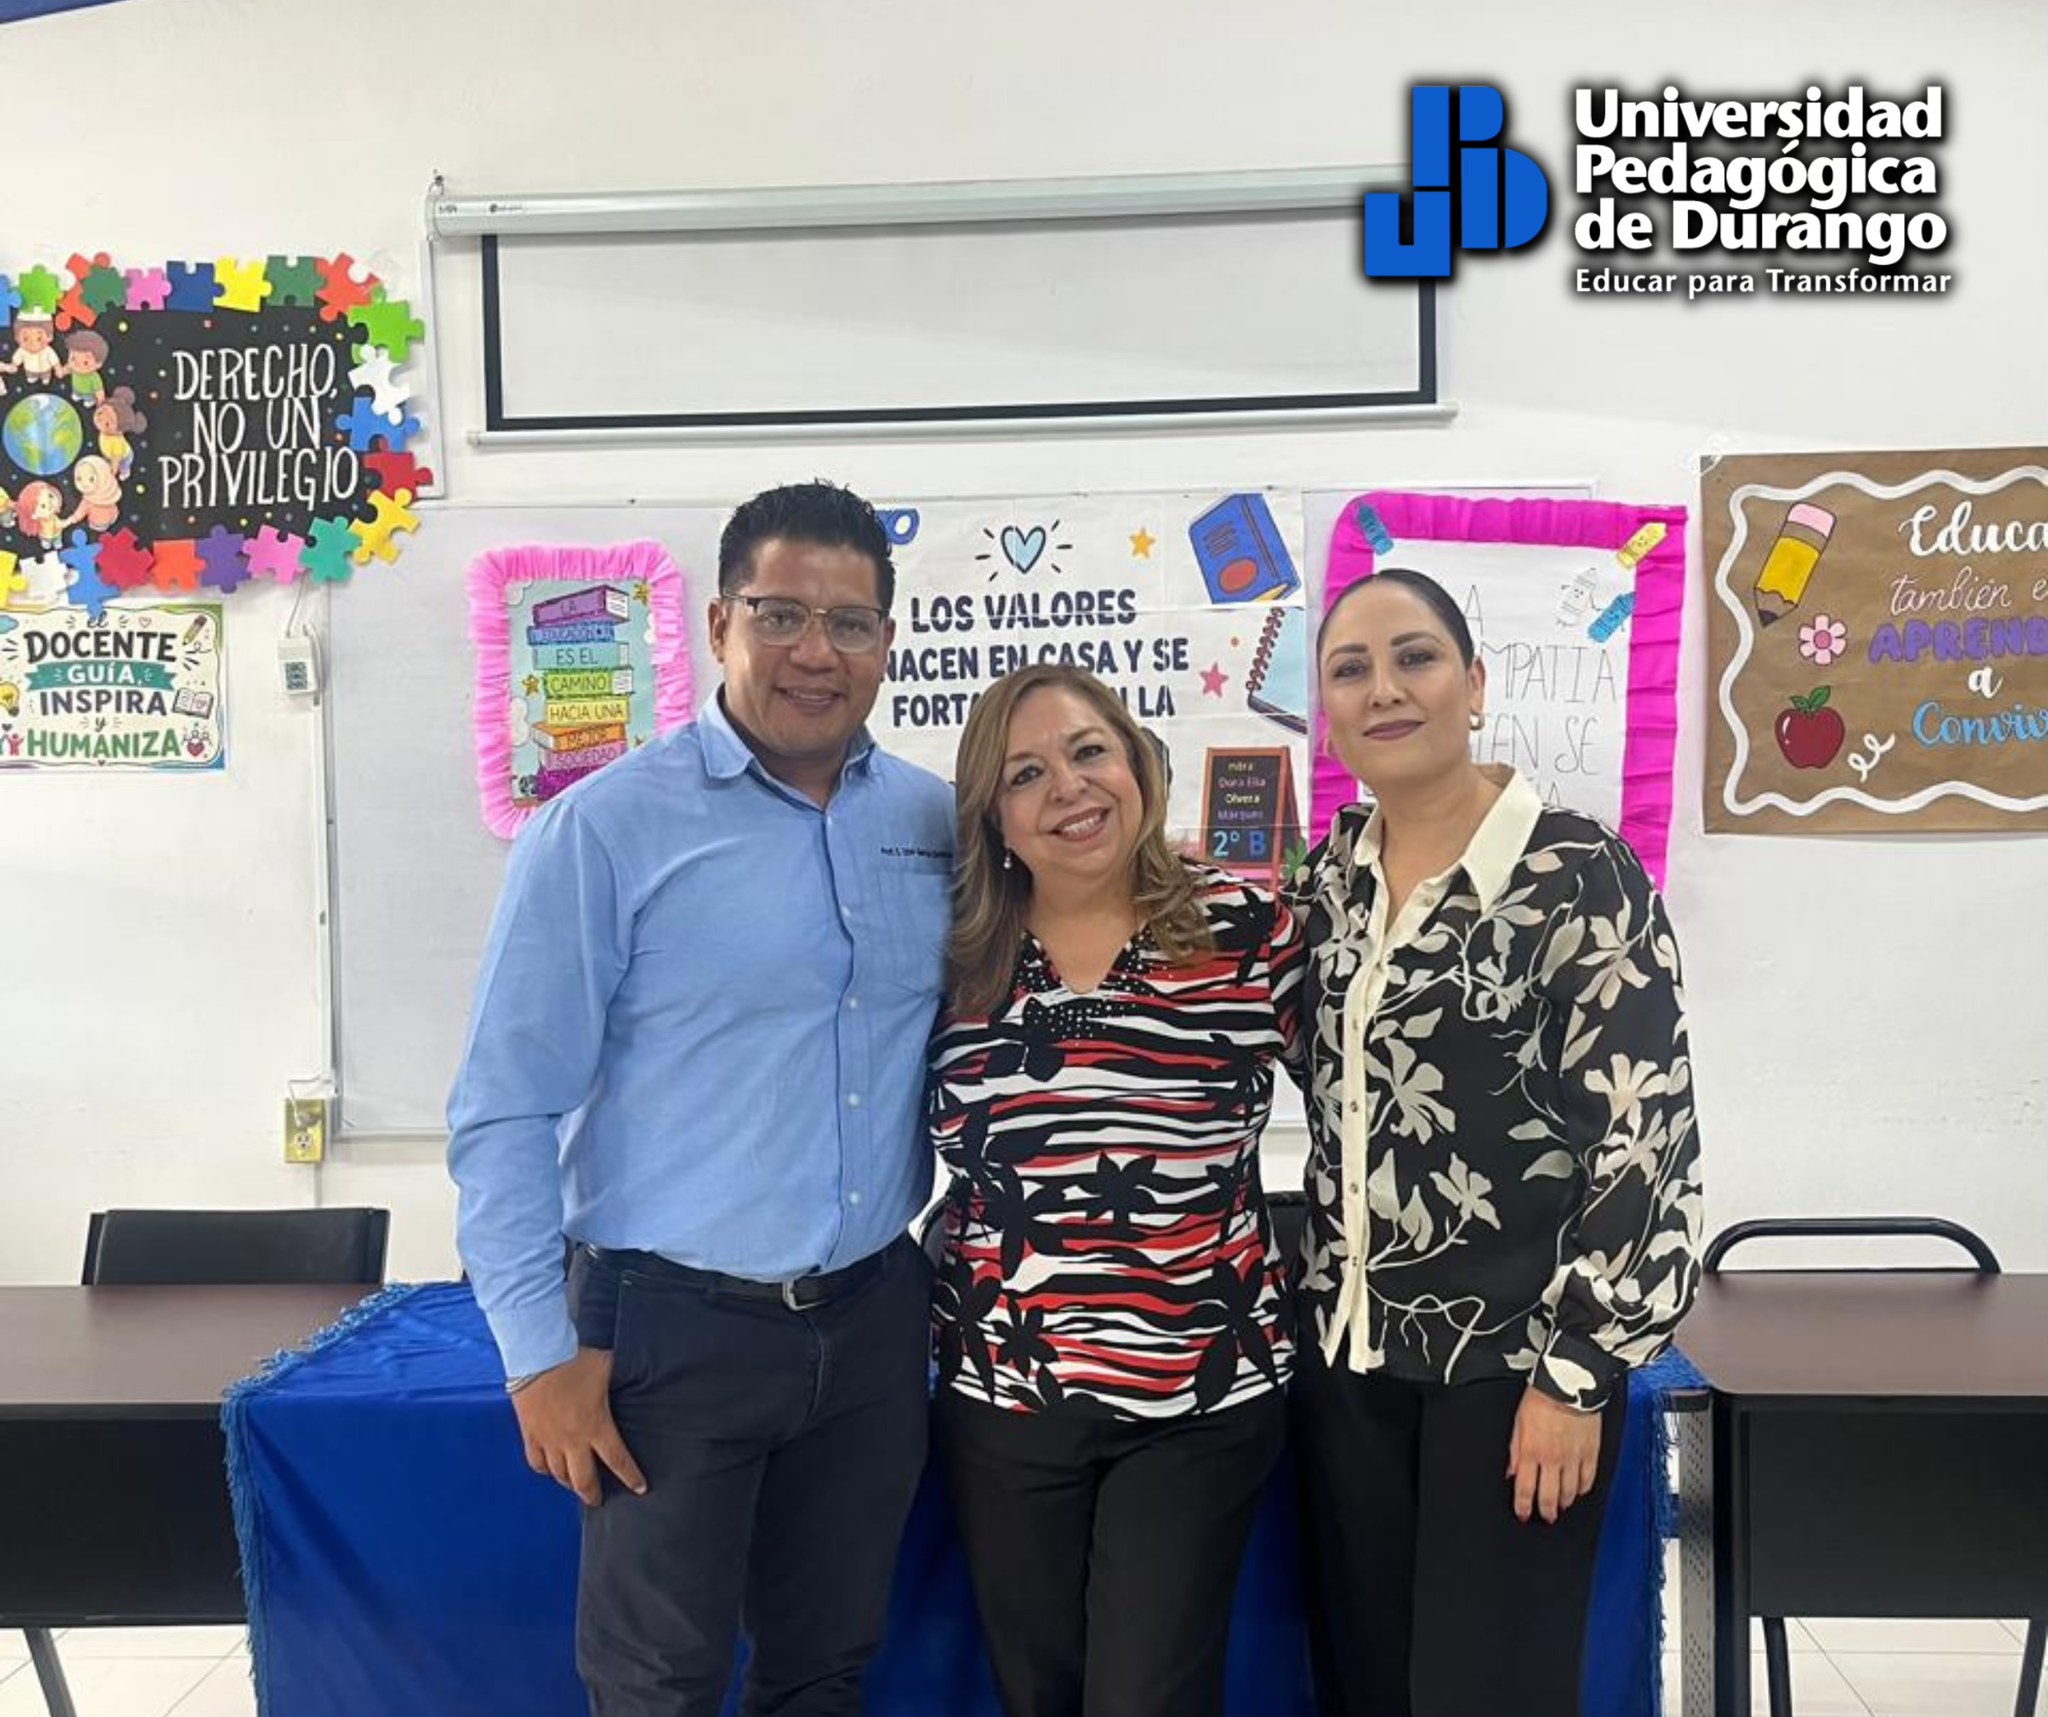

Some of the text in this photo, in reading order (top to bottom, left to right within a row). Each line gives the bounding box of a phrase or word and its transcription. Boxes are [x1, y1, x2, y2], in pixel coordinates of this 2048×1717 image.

[172, 343, 338, 401] DERECHO,
[193, 397, 321, 454] NO UN
[158, 446, 359, 511] PRIVILEGIO
[1898, 500, 2048, 557] Educa
[911, 588, 1137, 633] LOS VALORES
[1465, 584, 1483, 637] A
[23, 630, 177, 664] DOCENTE
[556, 647, 599, 667] ES EL
[887, 637, 1189, 682] NACEN EN CASA Y SE
[550, 674, 606, 692] CAMINO
[1480, 641, 1618, 703] MPATIA
[1968, 665, 2004, 698] a
[39, 689, 167, 717] INSPIRA
[550, 703, 624, 720] HACIA UNA
[1139, 685, 1176, 718] LA
[27, 728, 182, 758] HUMANIZA
[1555, 714, 1603, 775] SE
[1248, 830, 1267, 857] B
